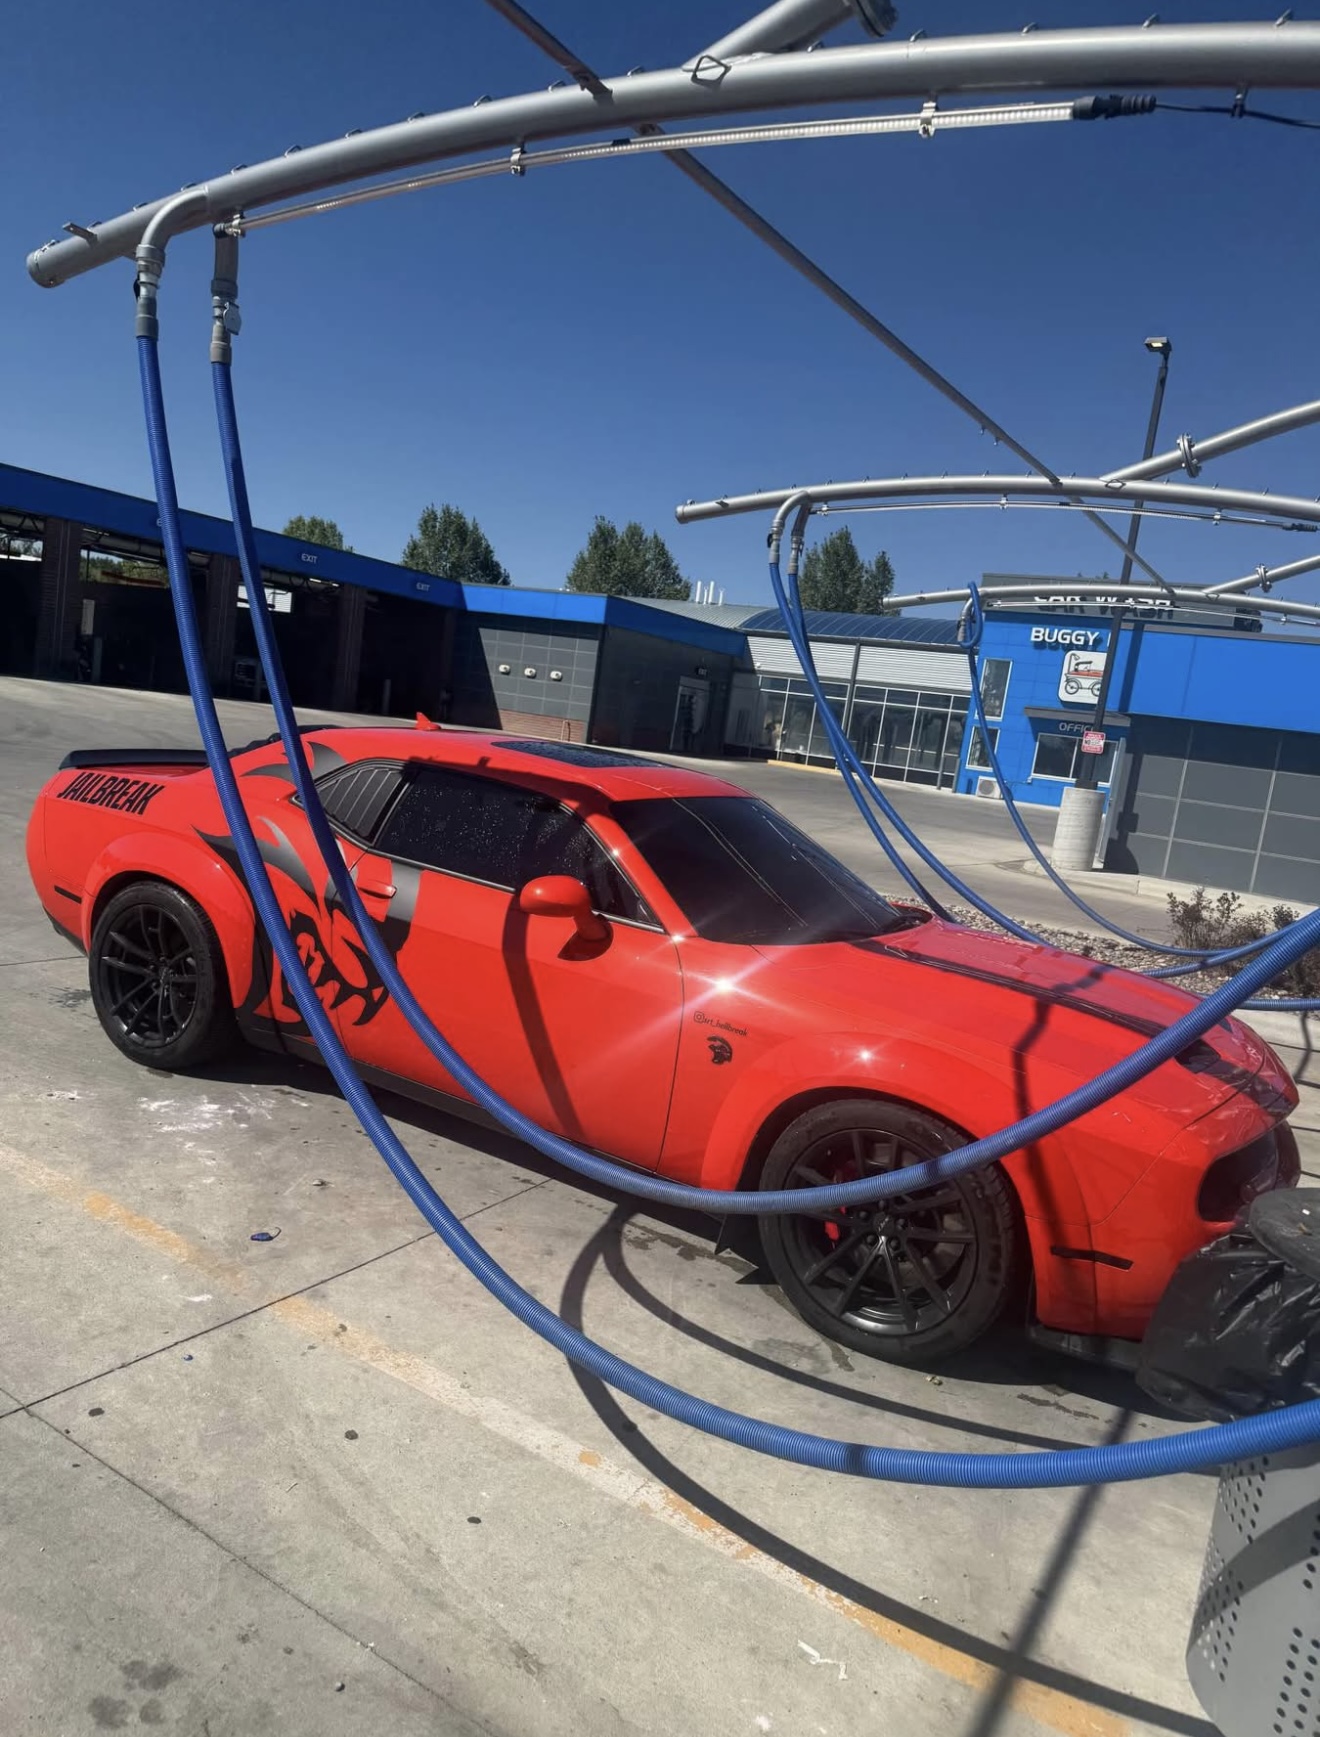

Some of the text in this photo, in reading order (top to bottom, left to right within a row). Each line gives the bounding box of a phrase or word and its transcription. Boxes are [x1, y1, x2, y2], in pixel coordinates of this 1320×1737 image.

[301, 552, 318, 564] EXIT
[1030, 626, 1100, 646] BUGGY
[56, 771, 165, 815] JAILBREAK
